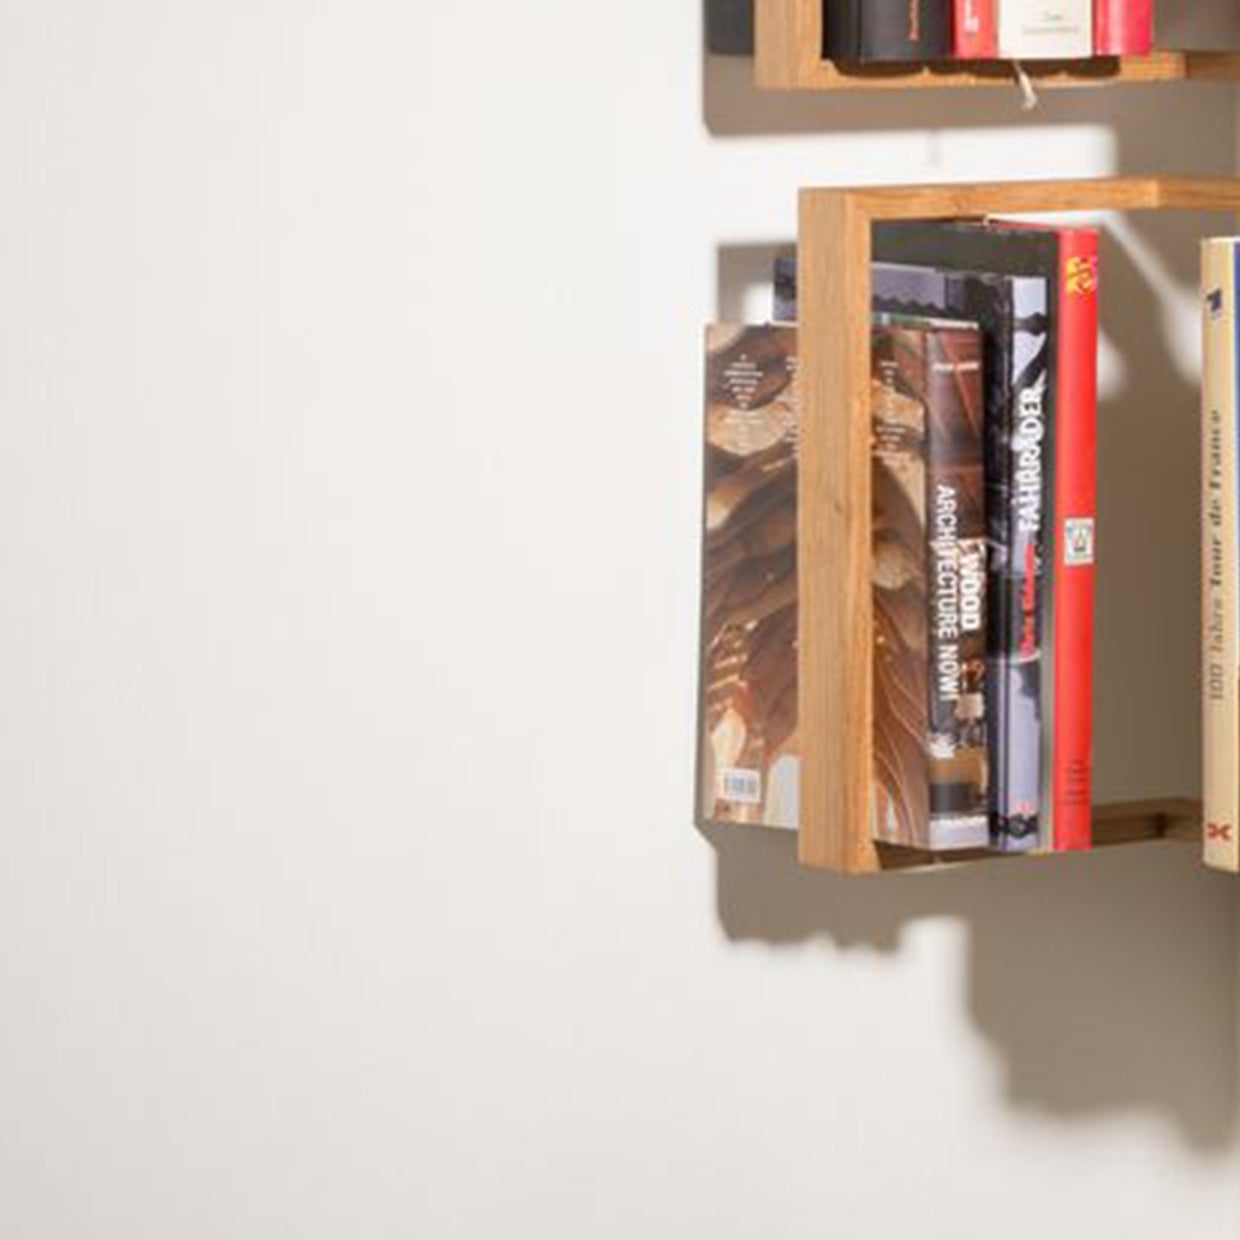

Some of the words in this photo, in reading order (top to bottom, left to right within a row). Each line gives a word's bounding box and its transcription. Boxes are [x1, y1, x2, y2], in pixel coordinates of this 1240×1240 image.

[1010, 386, 1044, 531] FAHRRÄDER
[1206, 409, 1224, 491] France
[1207, 499, 1223, 522] de
[935, 485, 958, 639] ARCHITECTURE
[1207, 534, 1224, 590] Tour
[960, 552, 981, 630] WOOD
[1208, 598, 1224, 655] Jahre
[938, 645, 958, 702] NOW!
[1209, 661, 1225, 702] 100
